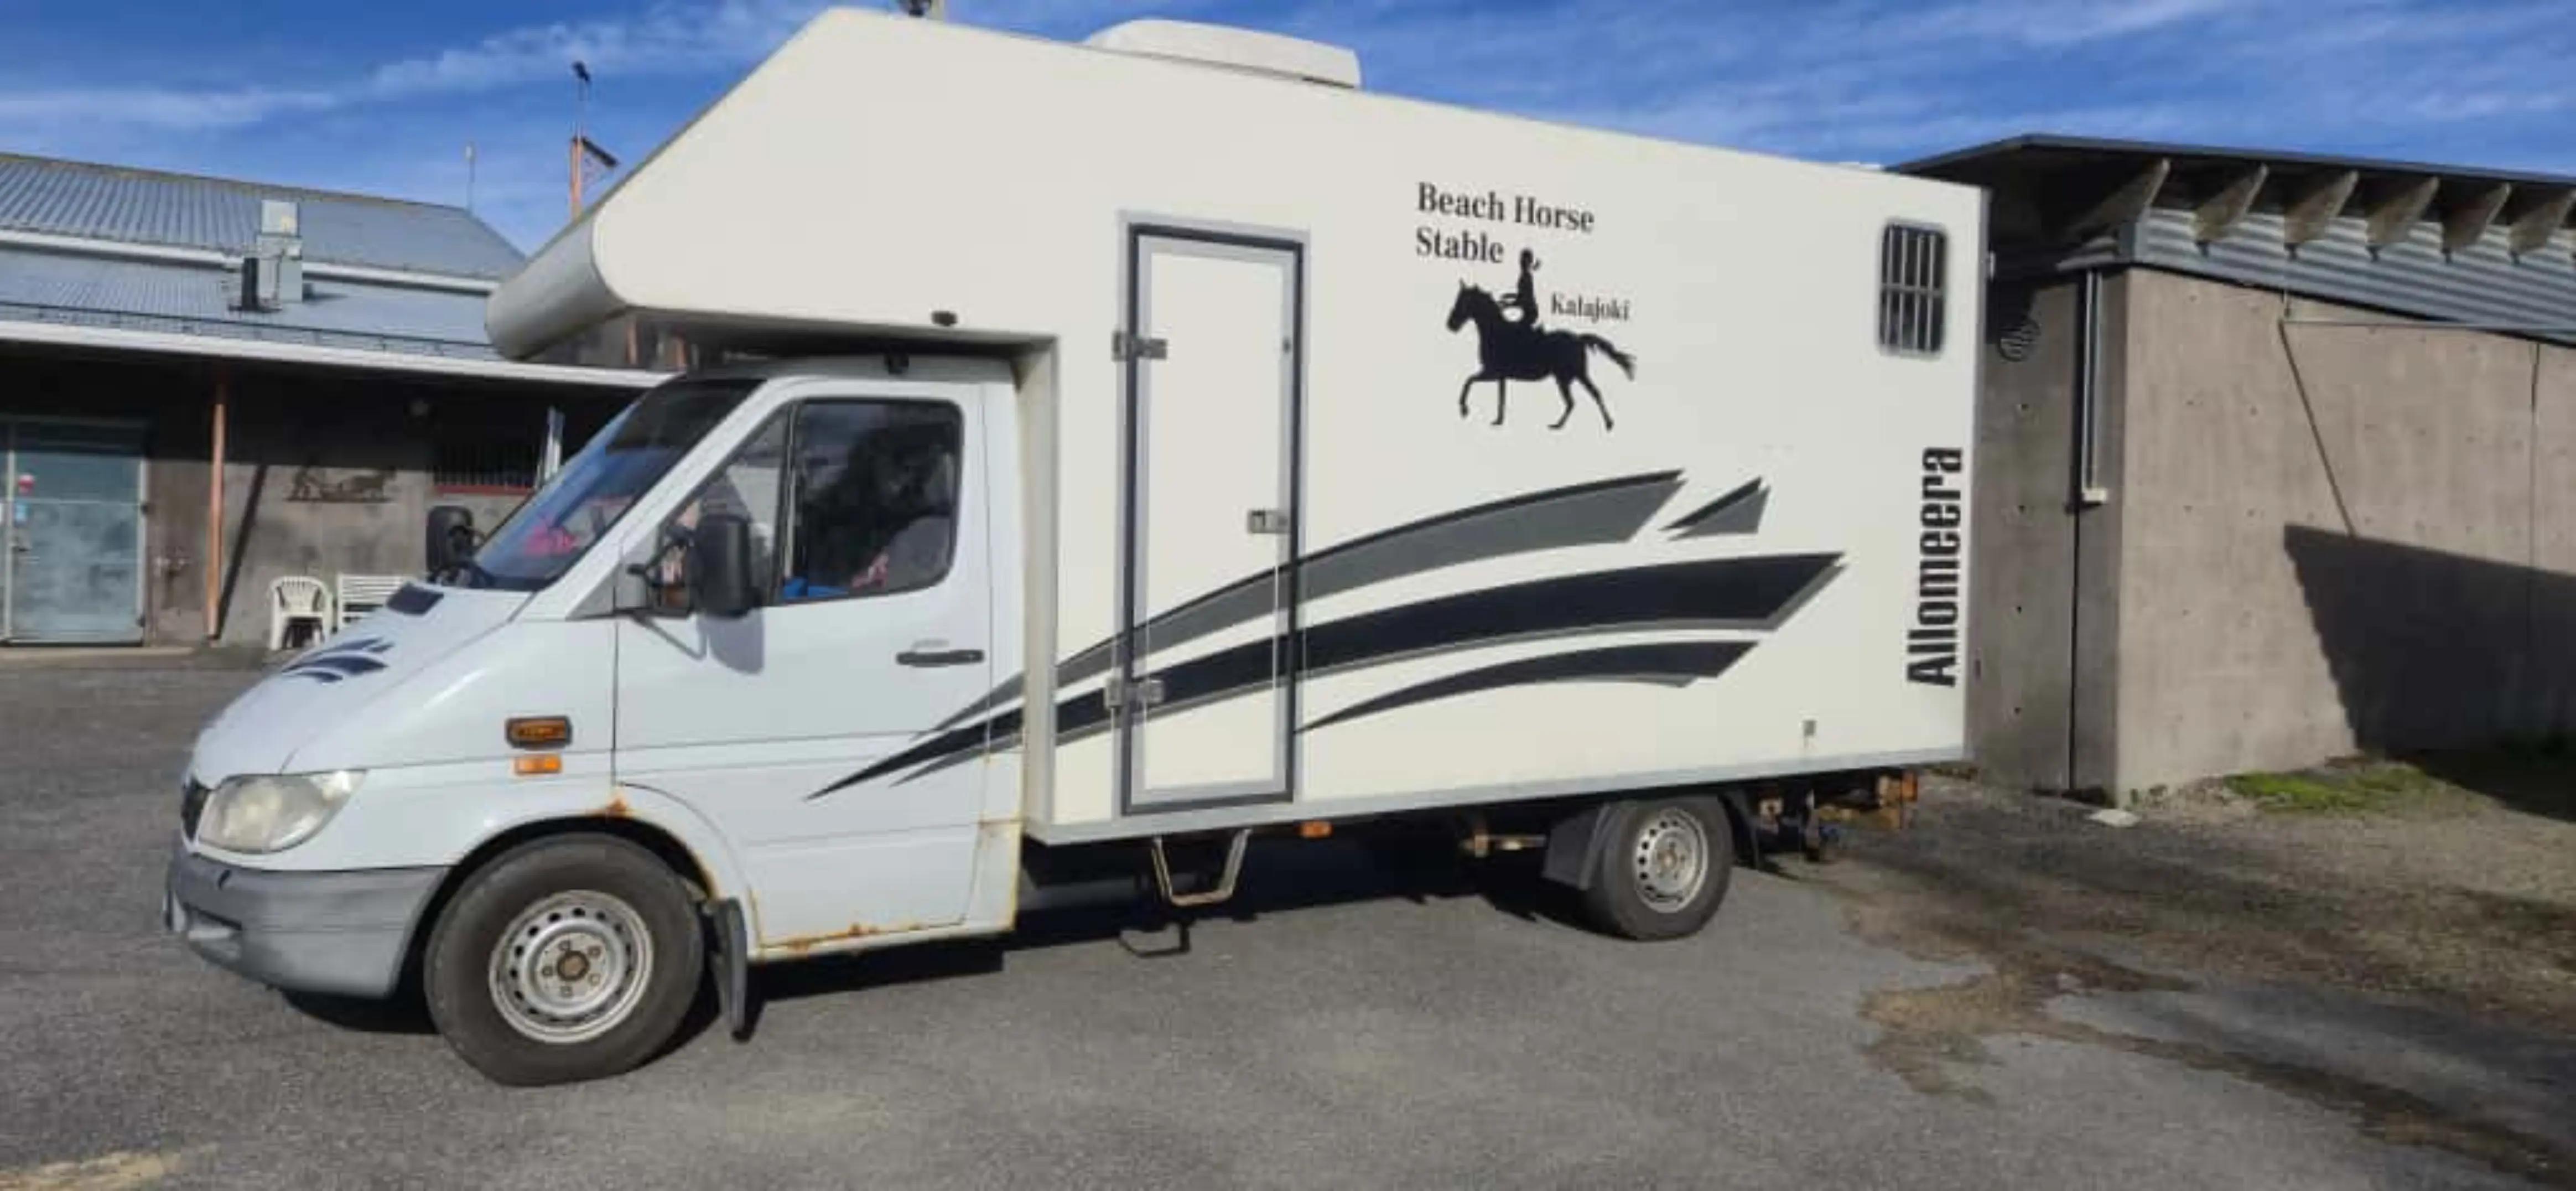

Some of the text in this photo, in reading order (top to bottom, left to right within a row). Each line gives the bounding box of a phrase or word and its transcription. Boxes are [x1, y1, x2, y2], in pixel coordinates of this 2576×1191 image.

[1417, 182, 1595, 232] Beach Horse
[1416, 227, 1504, 263] Stable
[1551, 292, 1629, 323] Kalajoki
[1906, 447, 1963, 688] Allomeera
